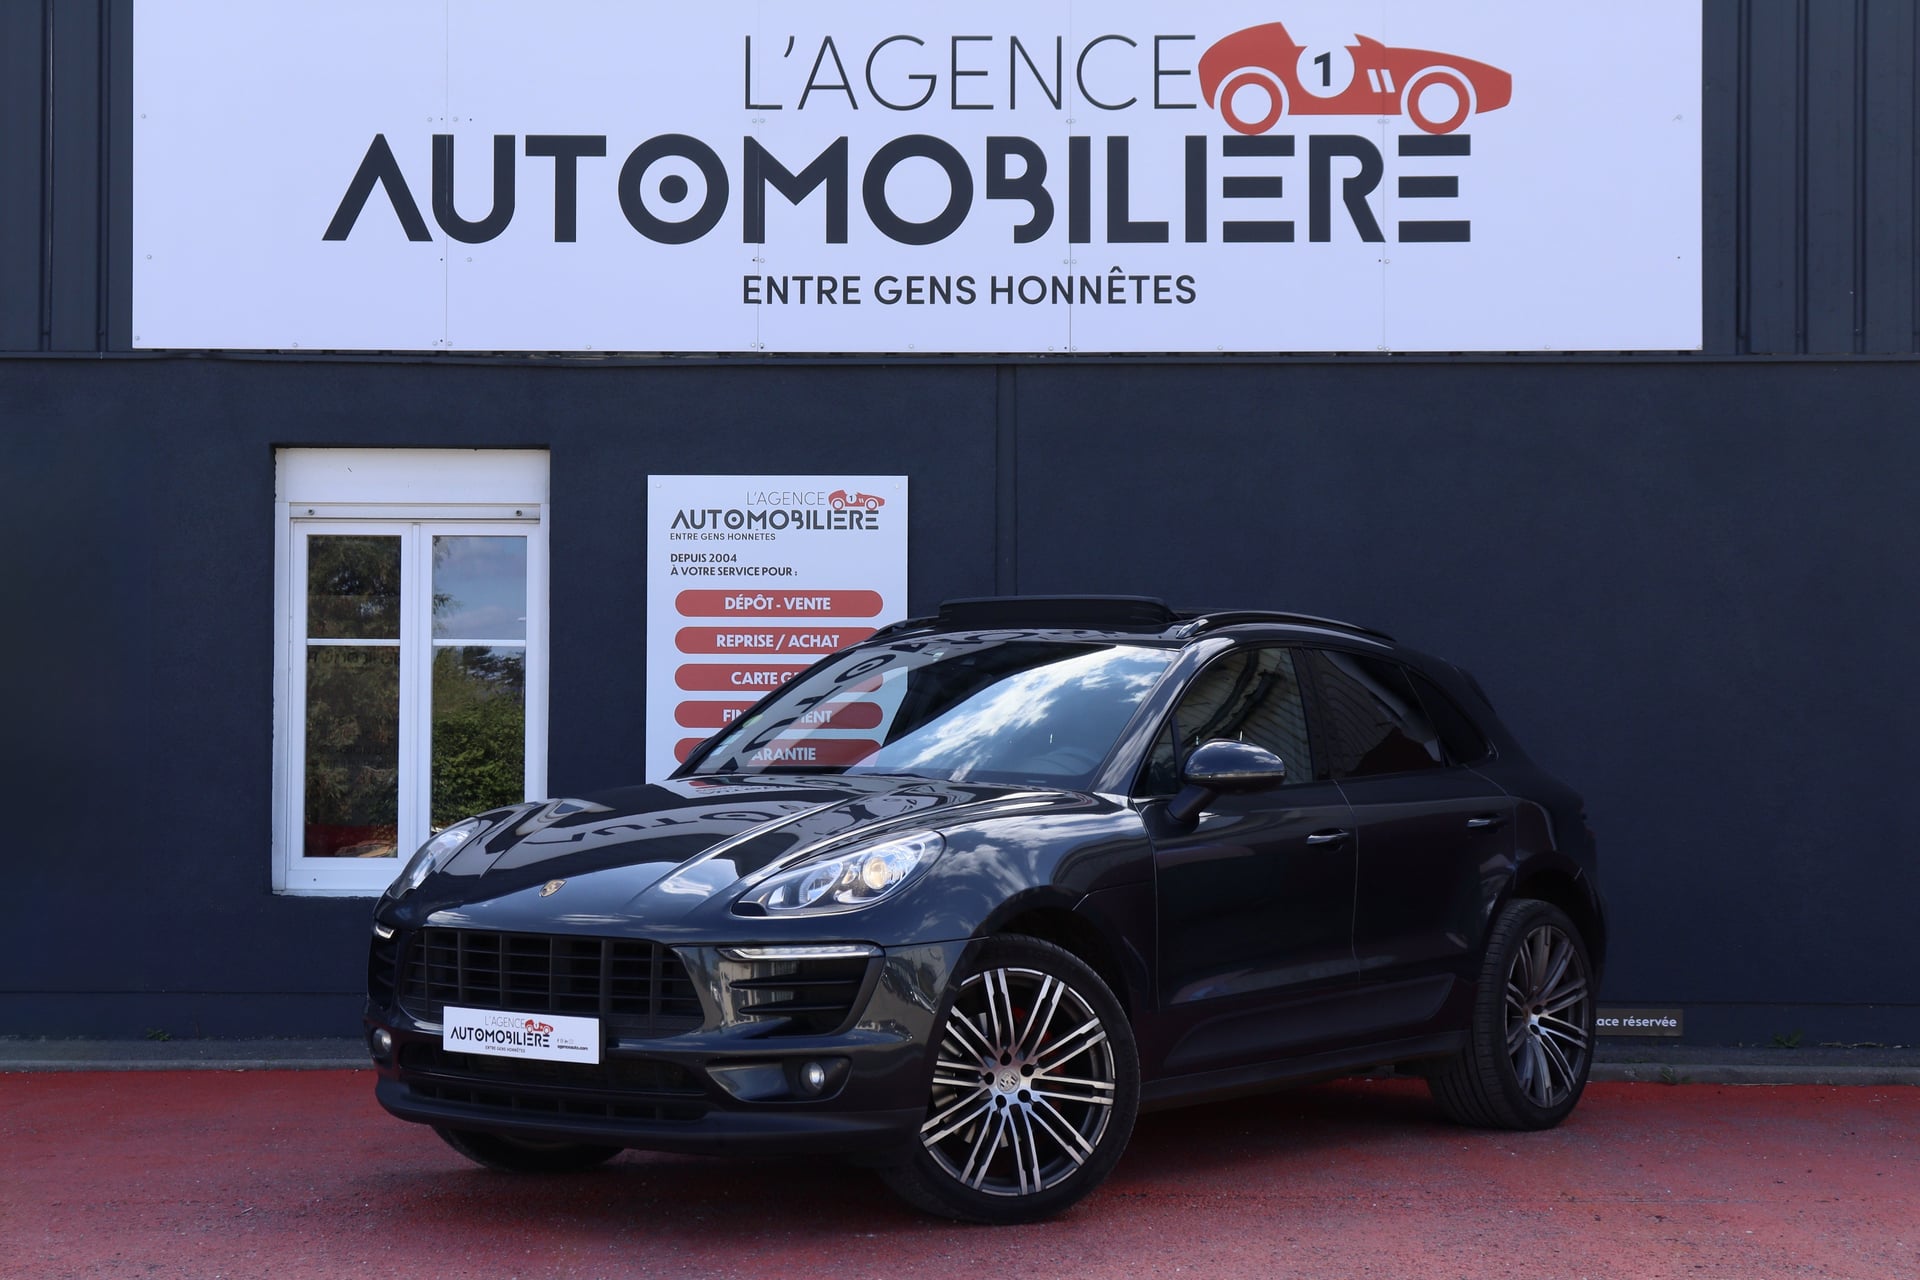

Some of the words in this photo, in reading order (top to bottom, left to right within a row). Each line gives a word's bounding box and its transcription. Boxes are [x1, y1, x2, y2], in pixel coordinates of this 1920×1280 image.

[744, 34, 1198, 112] L'AGENCE
[1313, 50, 1332, 87] 1
[743, 275, 862, 305] ENTRE
[874, 275, 978, 306] GENS
[990, 266, 1197, 306] HONNÊTES
[746, 491, 826, 506] L'AGENCE
[670, 532, 698, 541] ENTRE
[700, 532, 725, 541] GENS
[727, 529, 777, 541] HONNÊTES
[670, 553, 707, 563] DEPUIS
[709, 553, 738, 563] 2004
[670, 564, 679, 576] À
[680, 566, 716, 576] VOTRE
[717, 566, 763, 577] SERVICE
[762, 566, 793, 577] POUR
[724, 593, 774, 611] DÉPÔT
[783, 597, 831, 611] VENTE
[716, 634, 774, 648] REPRISE
[788, 634, 840, 648] ACHAT
[730, 671, 778, 685] CARTE
[1623, 1015, 1677, 1027] réservée
